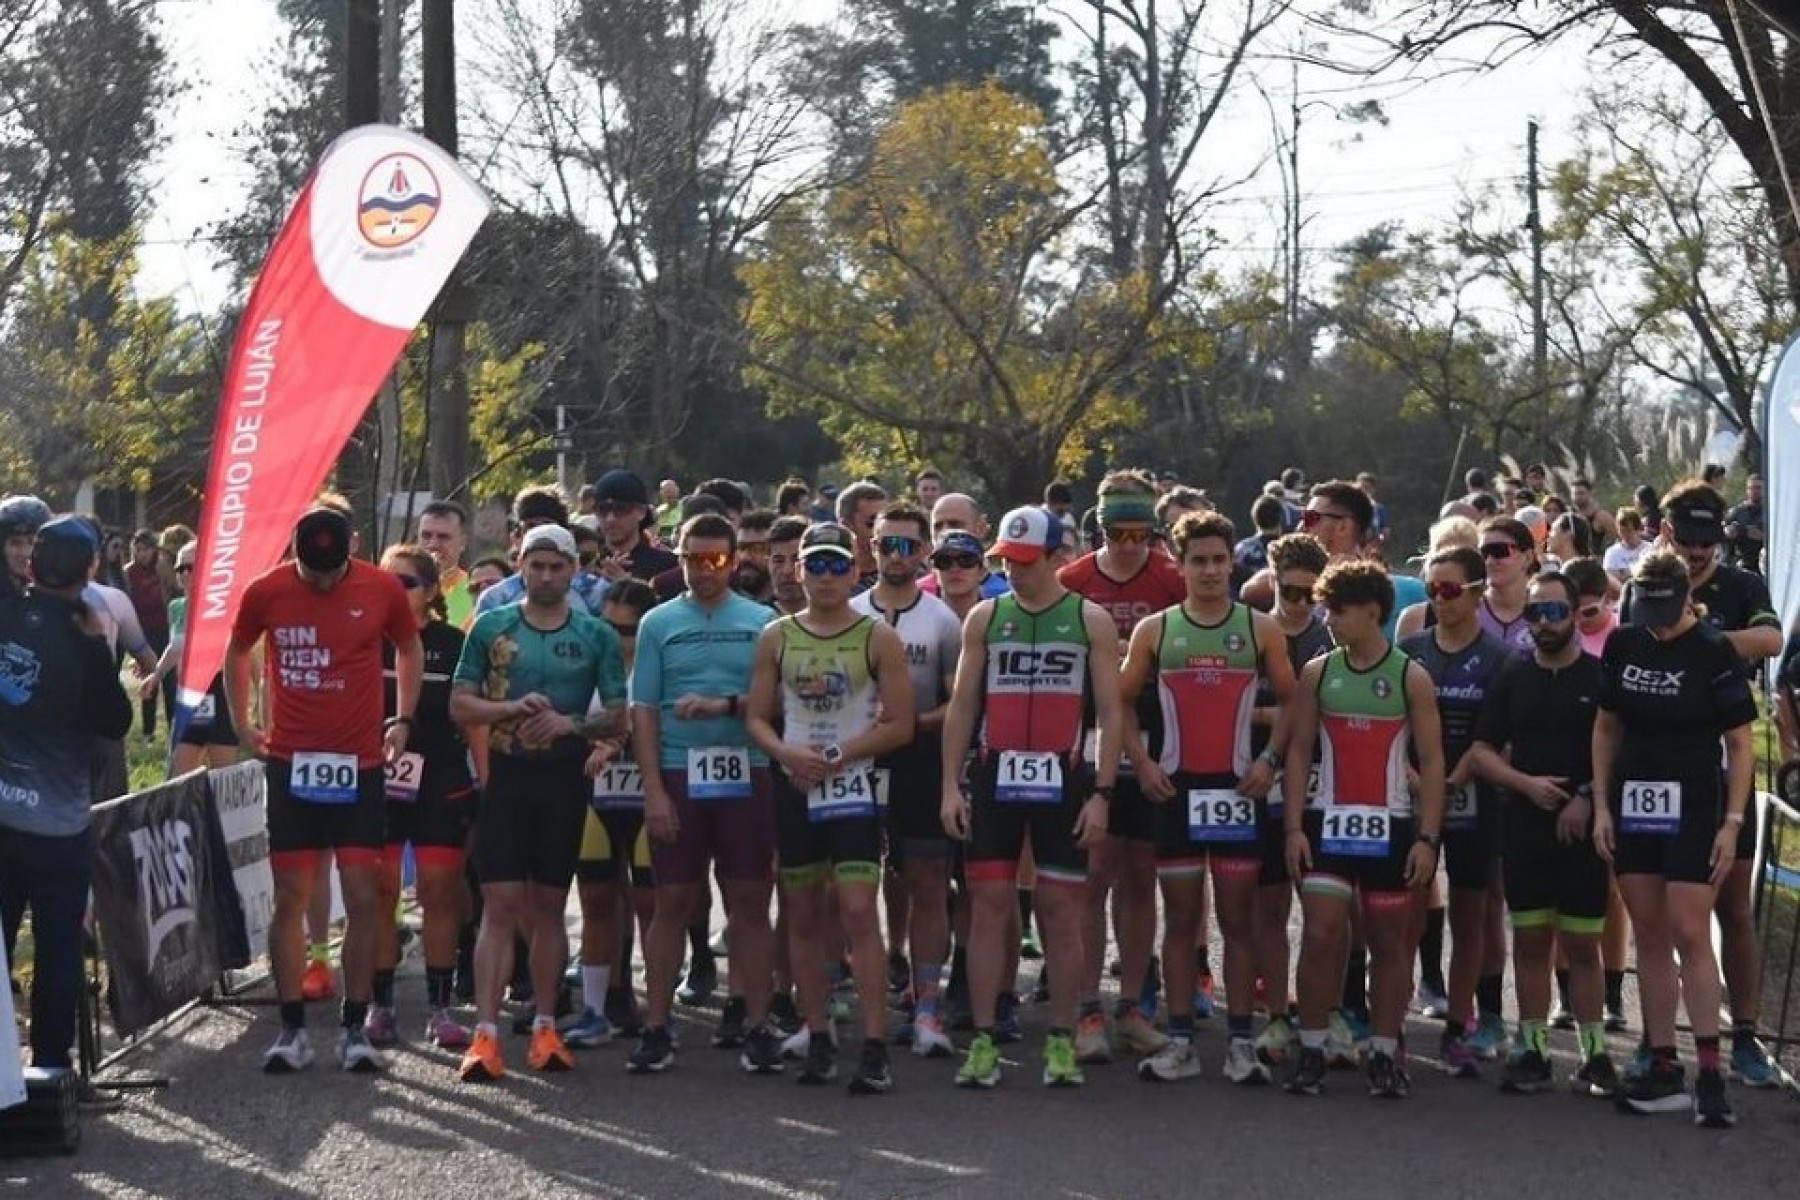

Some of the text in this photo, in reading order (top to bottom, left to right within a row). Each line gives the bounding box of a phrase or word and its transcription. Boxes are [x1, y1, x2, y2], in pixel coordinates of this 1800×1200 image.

[203, 318, 282, 618] MUNICIPIO DE LUJÁN
[274, 626, 317, 646] SIN
[999, 650, 1078, 676] ICS
[296, 762, 355, 787] 190
[697, 754, 742, 781] 158
[1006, 757, 1053, 783] 151
[820, 774, 865, 800] 154
[1194, 800, 1252, 826] 193
[1627, 787, 1670, 815] 181
[1325, 814, 1386, 839] 188
